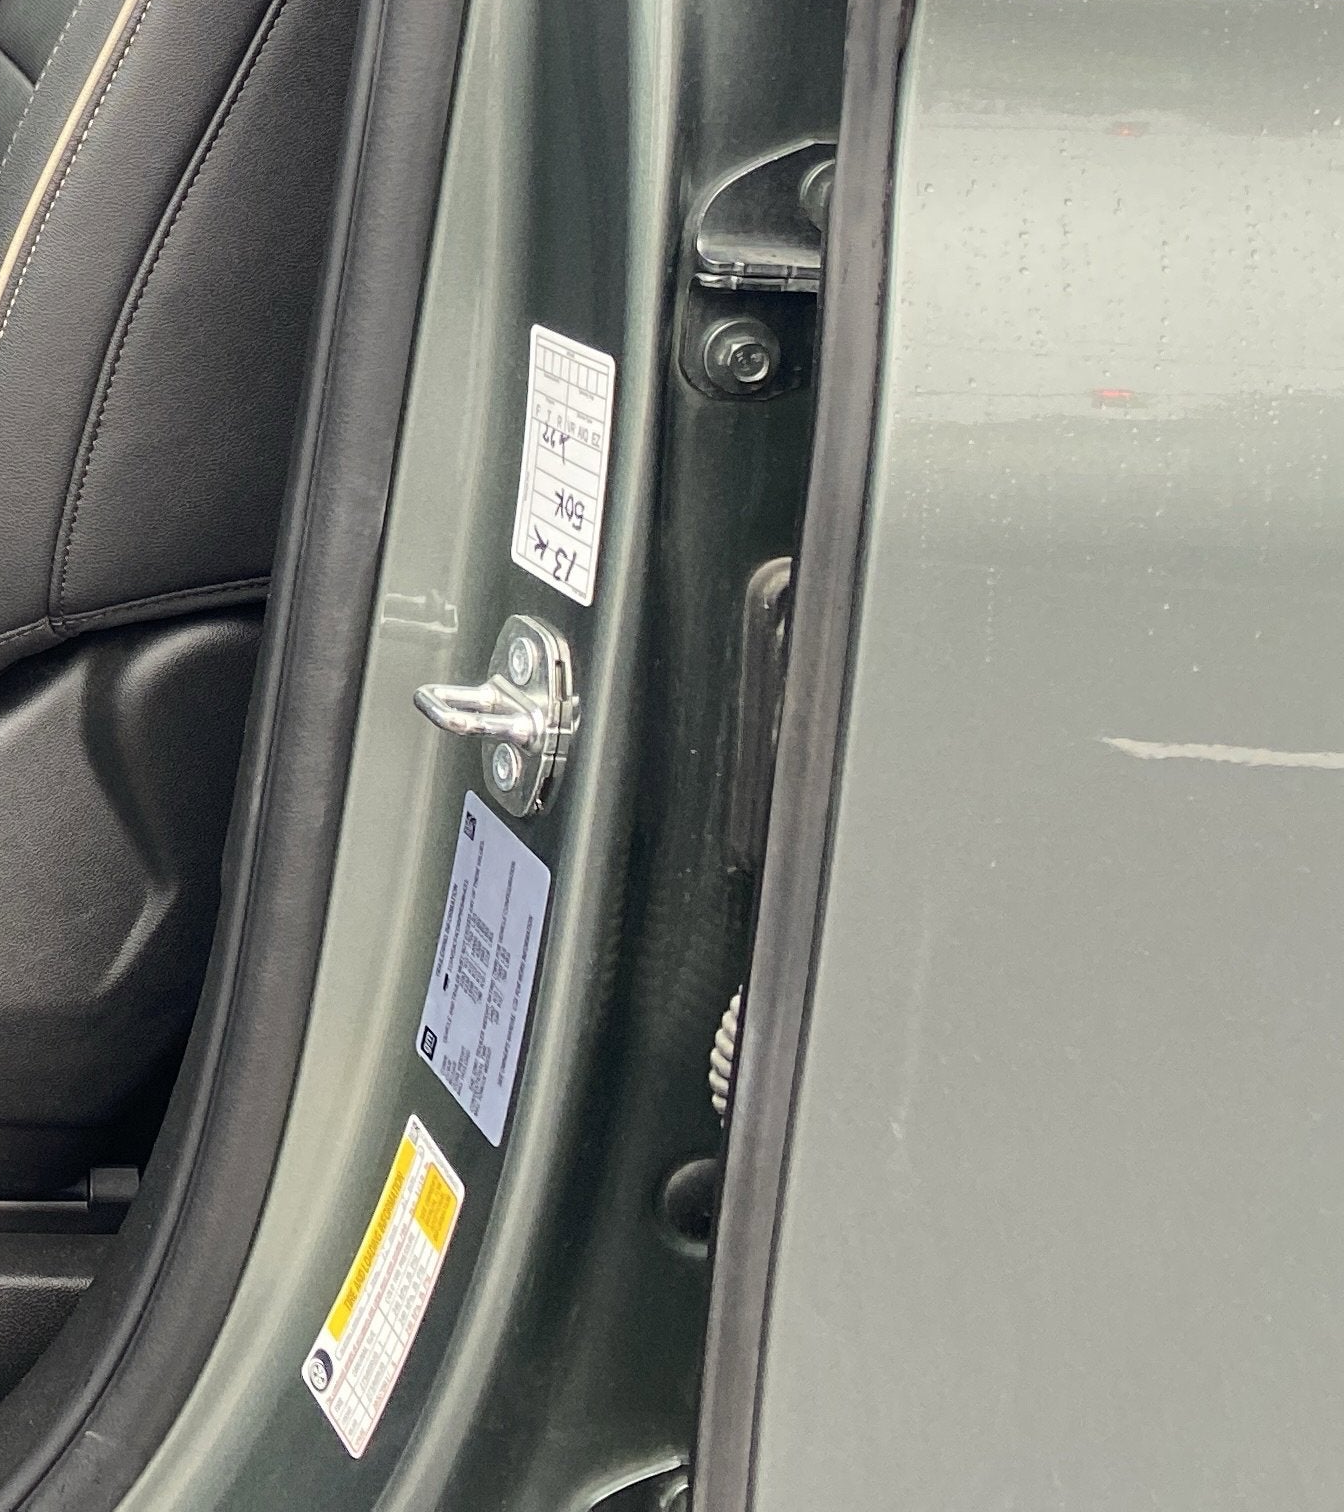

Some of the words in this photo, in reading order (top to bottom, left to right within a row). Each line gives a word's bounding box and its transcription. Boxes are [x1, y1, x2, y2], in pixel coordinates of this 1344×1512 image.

[423, 1028, 434, 1057] gm
[342, 1285, 357, 1314] TIRE
[360, 1228, 382, 1274] LOADING
[375, 1169, 406, 1235] INFORMATION
